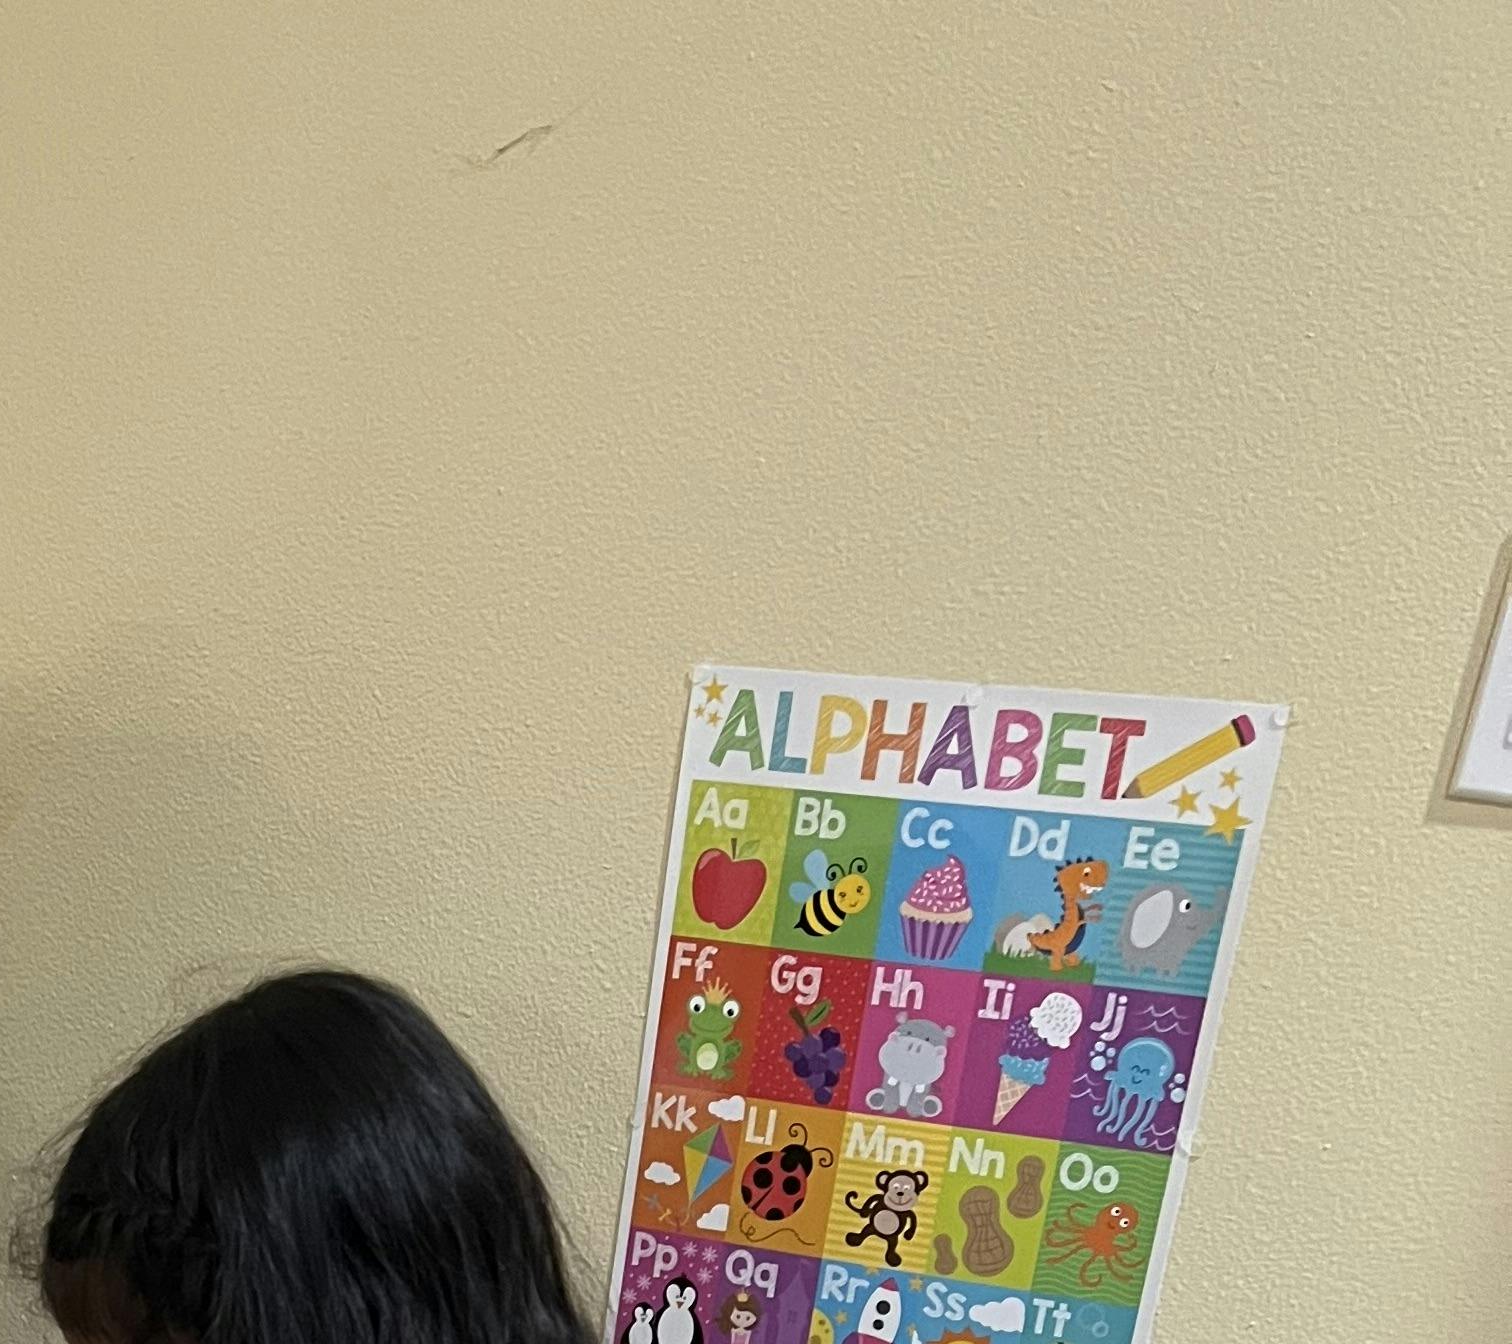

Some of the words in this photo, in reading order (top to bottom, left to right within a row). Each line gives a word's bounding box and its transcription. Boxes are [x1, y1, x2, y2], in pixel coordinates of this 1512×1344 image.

[709, 689, 1146, 800] ALPHABET
[693, 788, 748, 829] Aa
[795, 797, 846, 839] Bb
[900, 808, 954, 849] Cc
[1009, 816, 1069, 860] Dd
[1123, 827, 1180, 871] Ee
[671, 942, 718, 980] Ff
[770, 955, 823, 1003] Gg
[871, 968, 923, 1009] Hh
[978, 979, 1014, 1021] Ii
[1090, 991, 1128, 1041] Jj
[651, 1094, 697, 1133] Kk
[746, 1107, 776, 1145] Ll
[845, 1123, 924, 1168] Mm
[949, 1137, 1004, 1179] Nn
[1059, 1152, 1120, 1194] Oo
[631, 1231, 679, 1278] Pp
[724, 1250, 778, 1298] Qq
[822, 1264, 870, 1303] Rr
[923, 1282, 966, 1320] Ss
[1031, 1298, 1072, 1338] Tt
